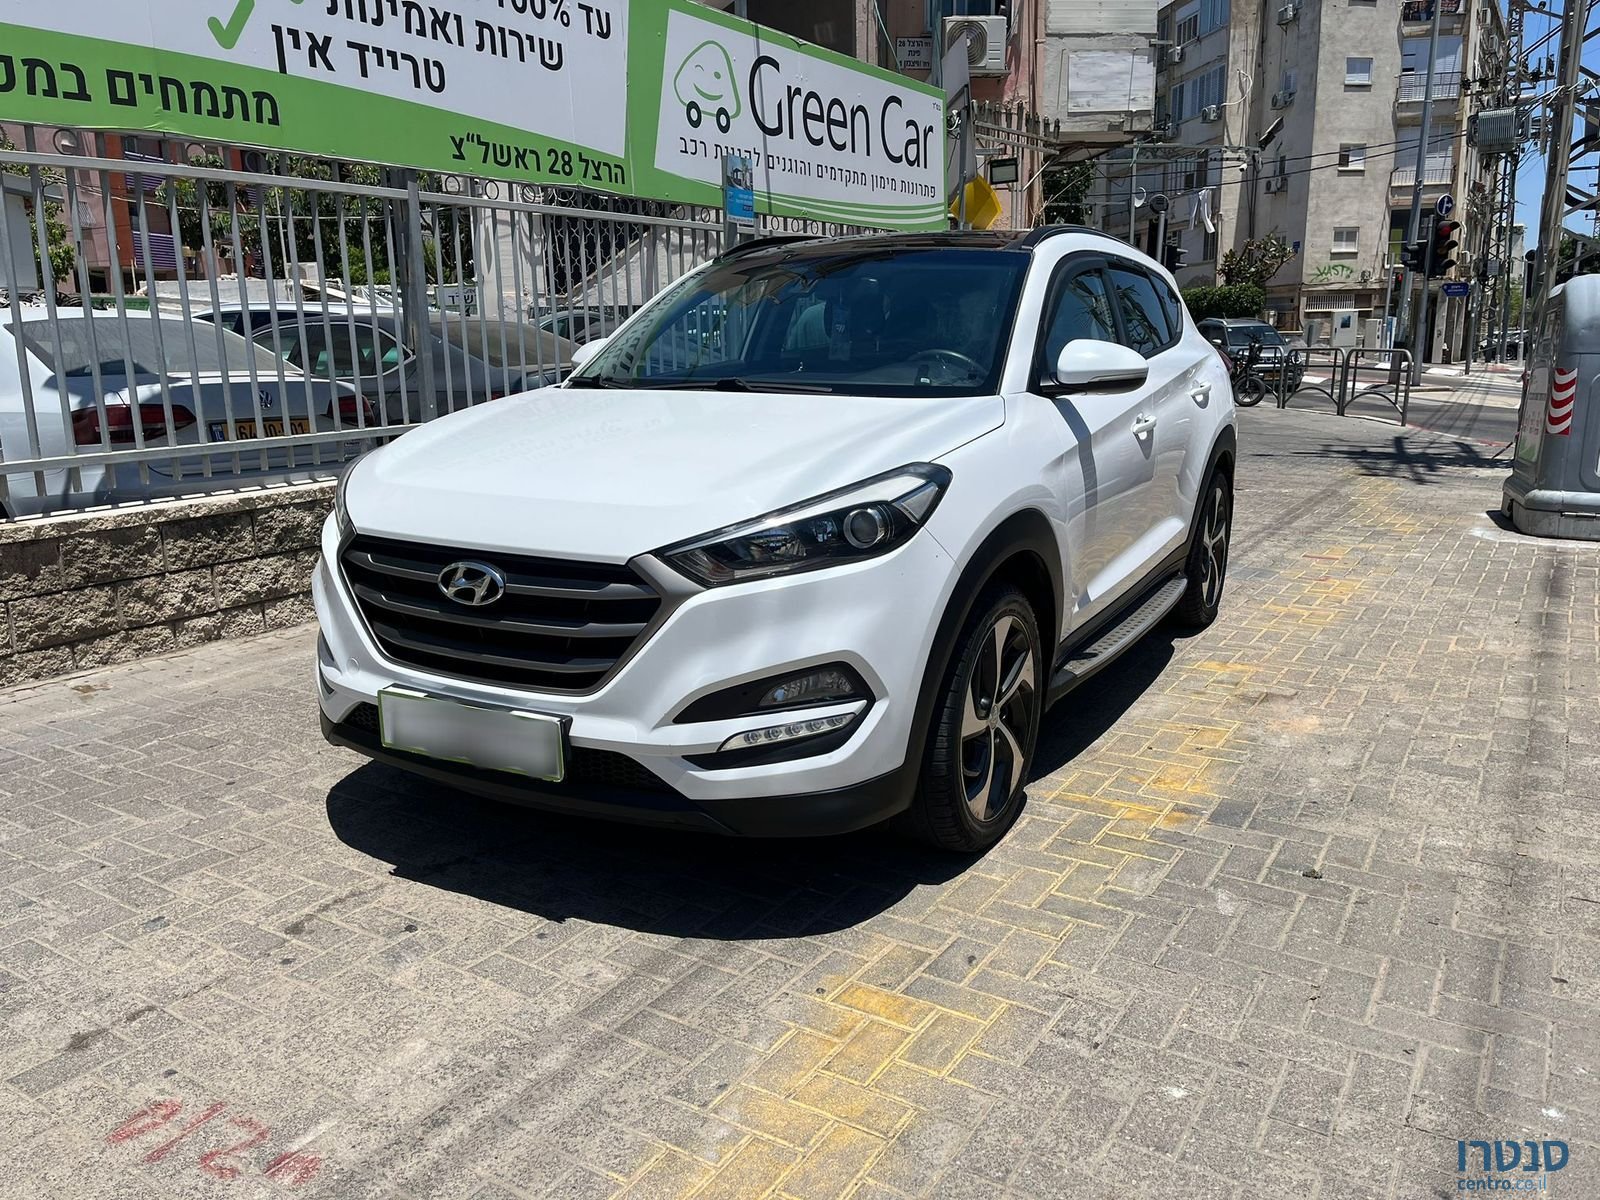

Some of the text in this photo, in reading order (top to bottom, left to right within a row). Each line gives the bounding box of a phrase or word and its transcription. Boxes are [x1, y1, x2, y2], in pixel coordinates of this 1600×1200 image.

[326, 0, 564, 71] שירות ואמינות
[577, 2, 611, 40] עד
[271, 24, 446, 93] טרייד אין
[105, 68, 280, 126] מתמחים
[749, 55, 935, 169] Green Car
[449, 131, 626, 185] הרצל 28 ראשל"צ
[680, 136, 707, 158] רכב
[767, 154, 811, 177] והוגנים
[816, 163, 867, 187] מתקדמים
[871, 173, 897, 192] מימון
[900, 179, 936, 198] פתרונות
